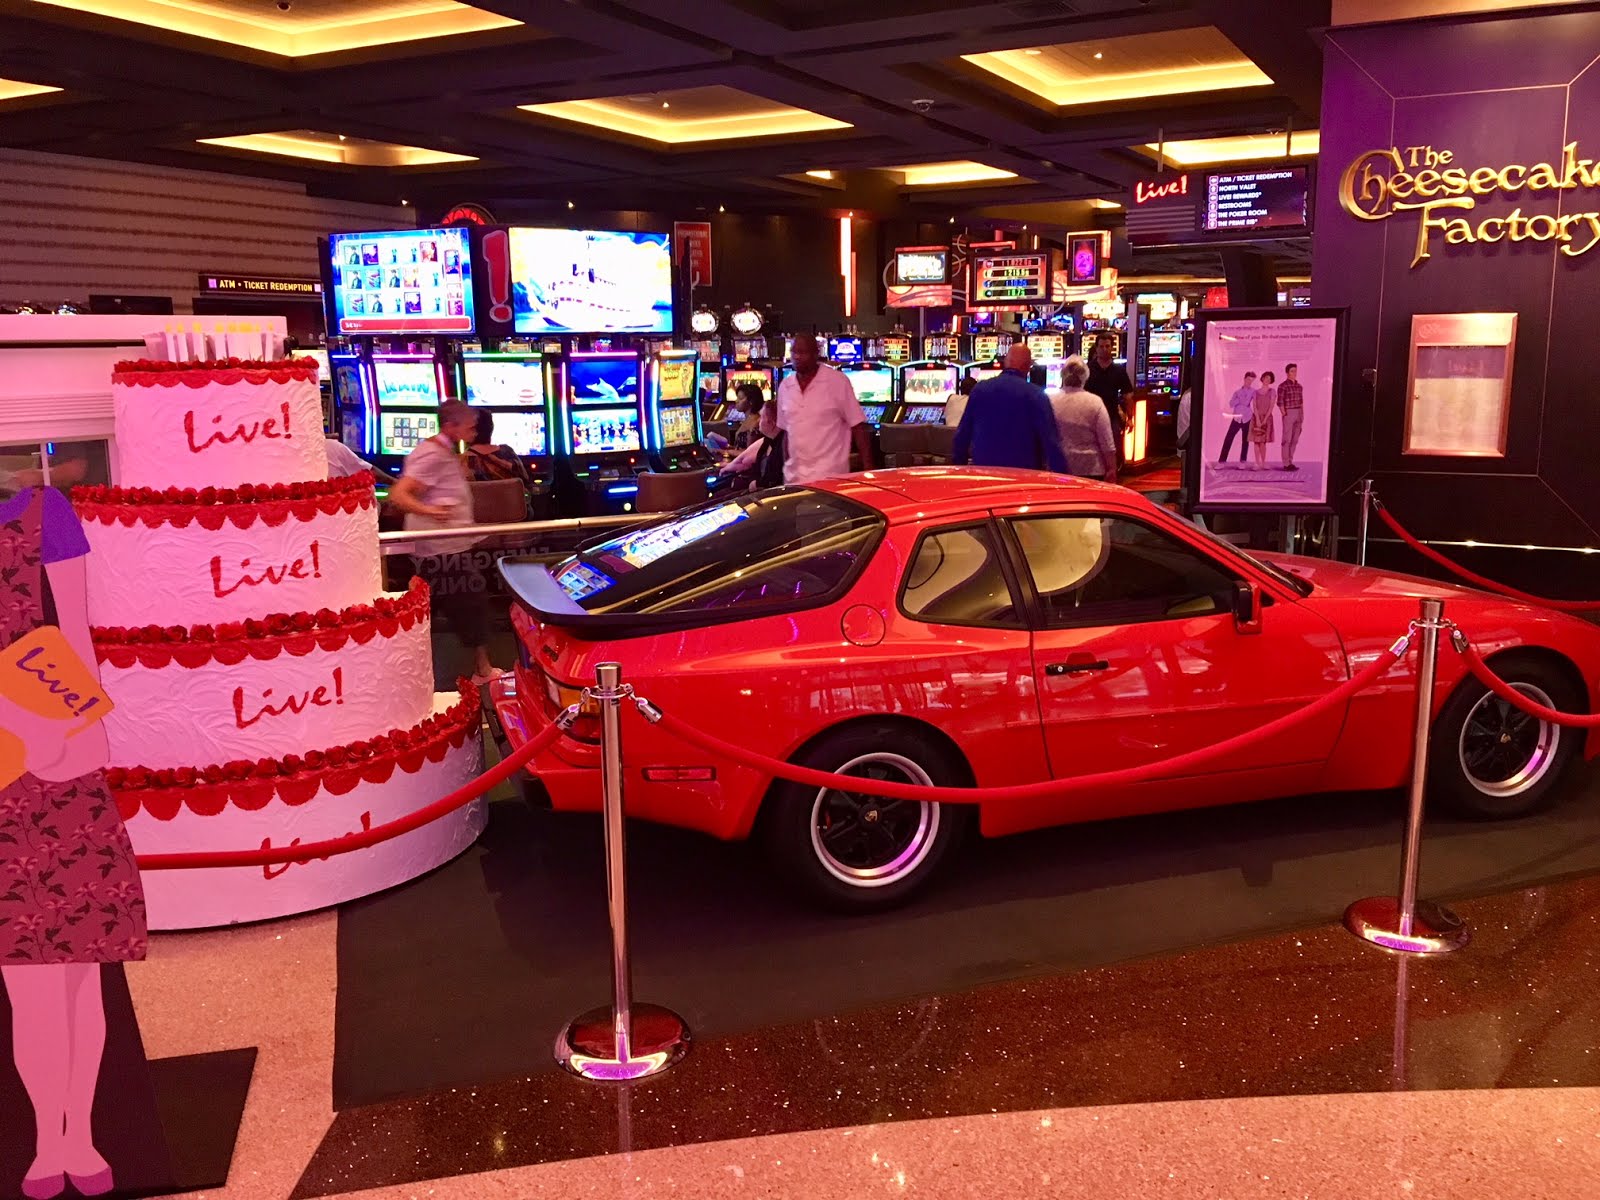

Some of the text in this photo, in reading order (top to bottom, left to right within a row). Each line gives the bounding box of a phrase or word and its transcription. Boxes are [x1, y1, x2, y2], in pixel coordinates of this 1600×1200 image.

[1404, 145, 1454, 169] The
[1135, 174, 1188, 203] Live!
[1219, 176, 1232, 184] ATM
[1256, 172, 1293, 181] REDEMPTION
[1219, 183, 1257, 192] NORTH VALET
[1218, 201, 1252, 210] RESTROOMS
[1218, 209, 1268, 219] THE POKER ROOM
[1392, 197, 1600, 269] Factory
[220, 279, 313, 292] ATM TICKET REDEMPTION
[184, 402, 292, 453] Live!
[210, 540, 323, 598] Live!
[16, 646, 99, 718] Live!
[232, 667, 343, 729] Live!
